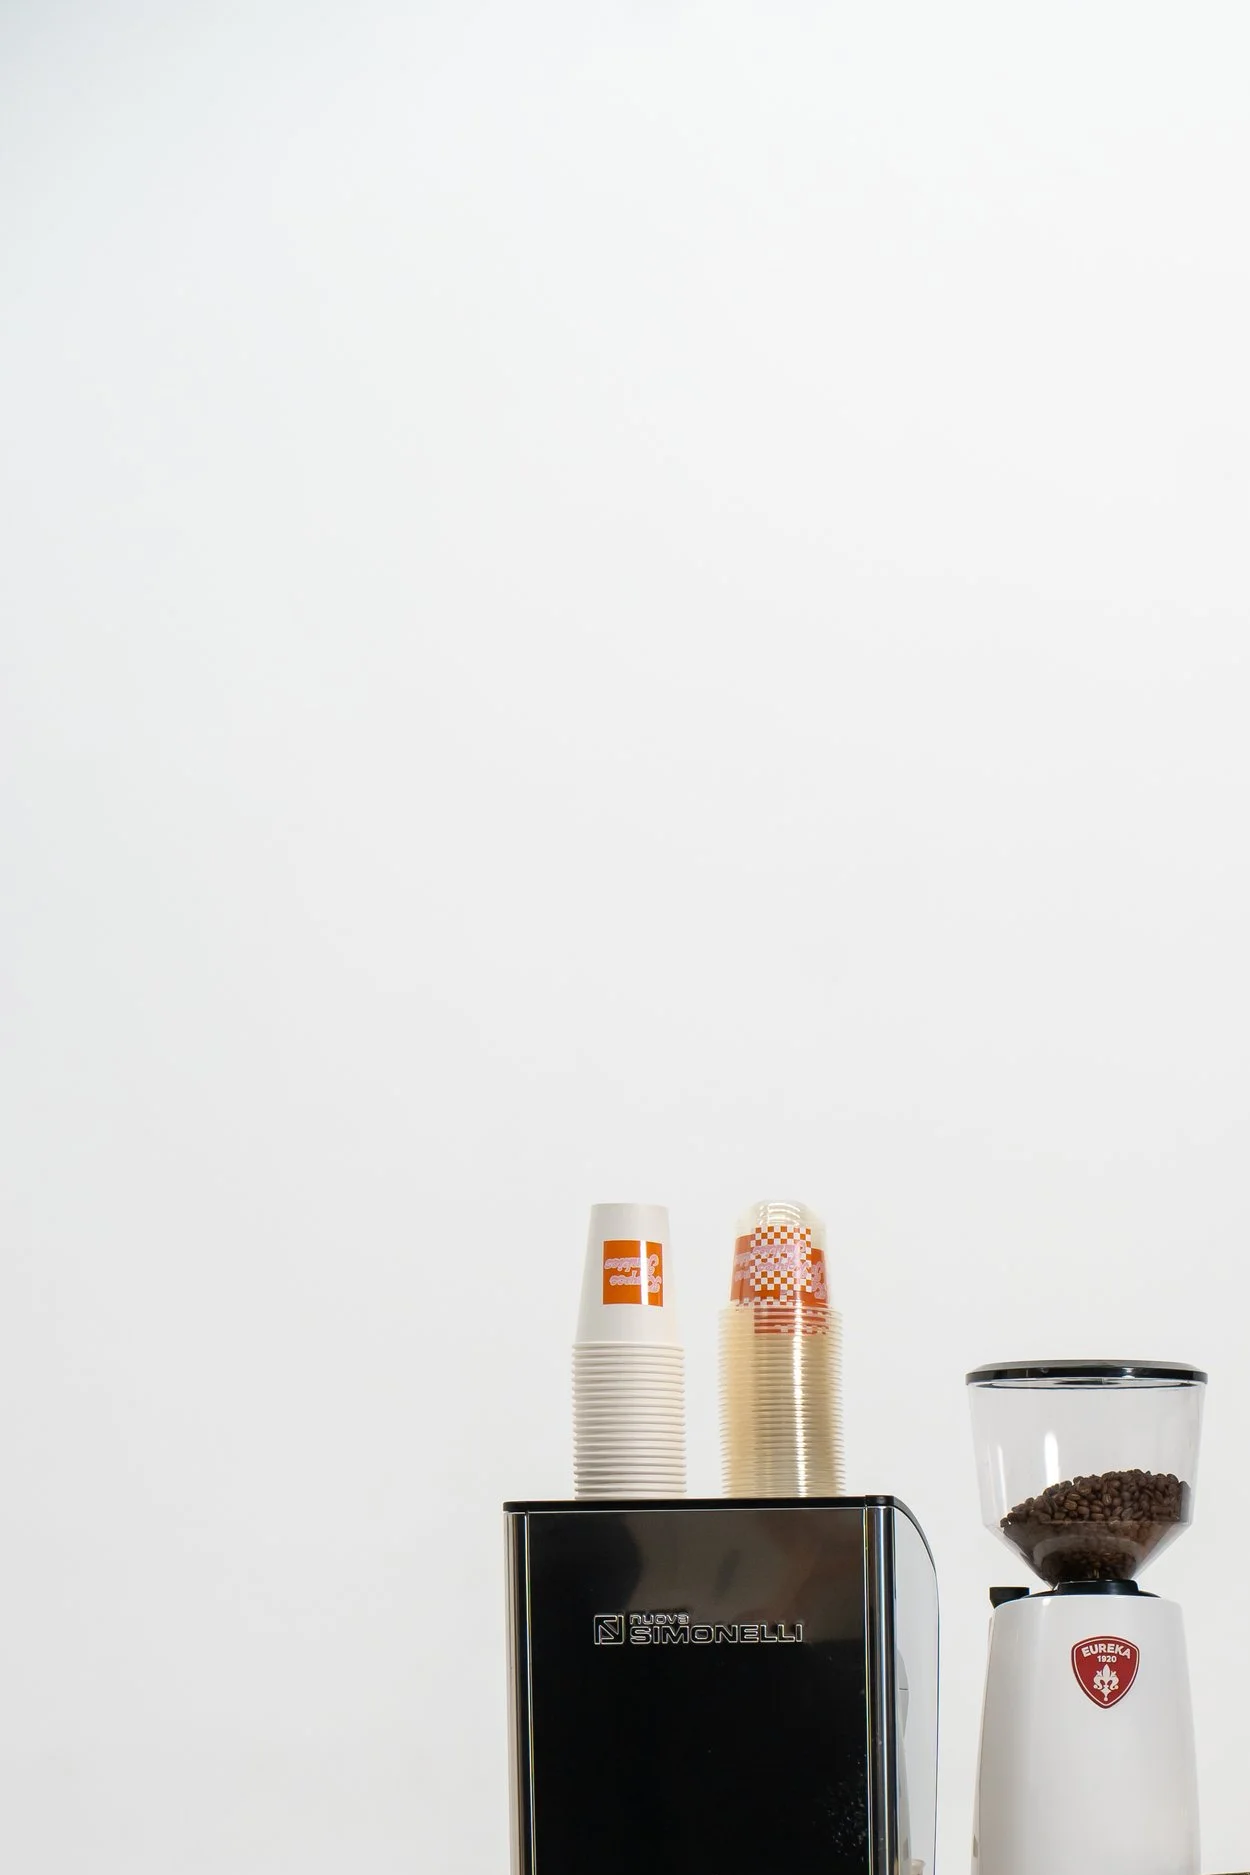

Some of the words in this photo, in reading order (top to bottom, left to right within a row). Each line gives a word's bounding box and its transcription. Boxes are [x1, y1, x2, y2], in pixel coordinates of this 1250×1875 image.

[629, 1614, 689, 1625] nuova
[630, 1624, 803, 1644] SIMONELLI
[1081, 1643, 1131, 1660] EUREKA
[1096, 1655, 1117, 1663] 1920
